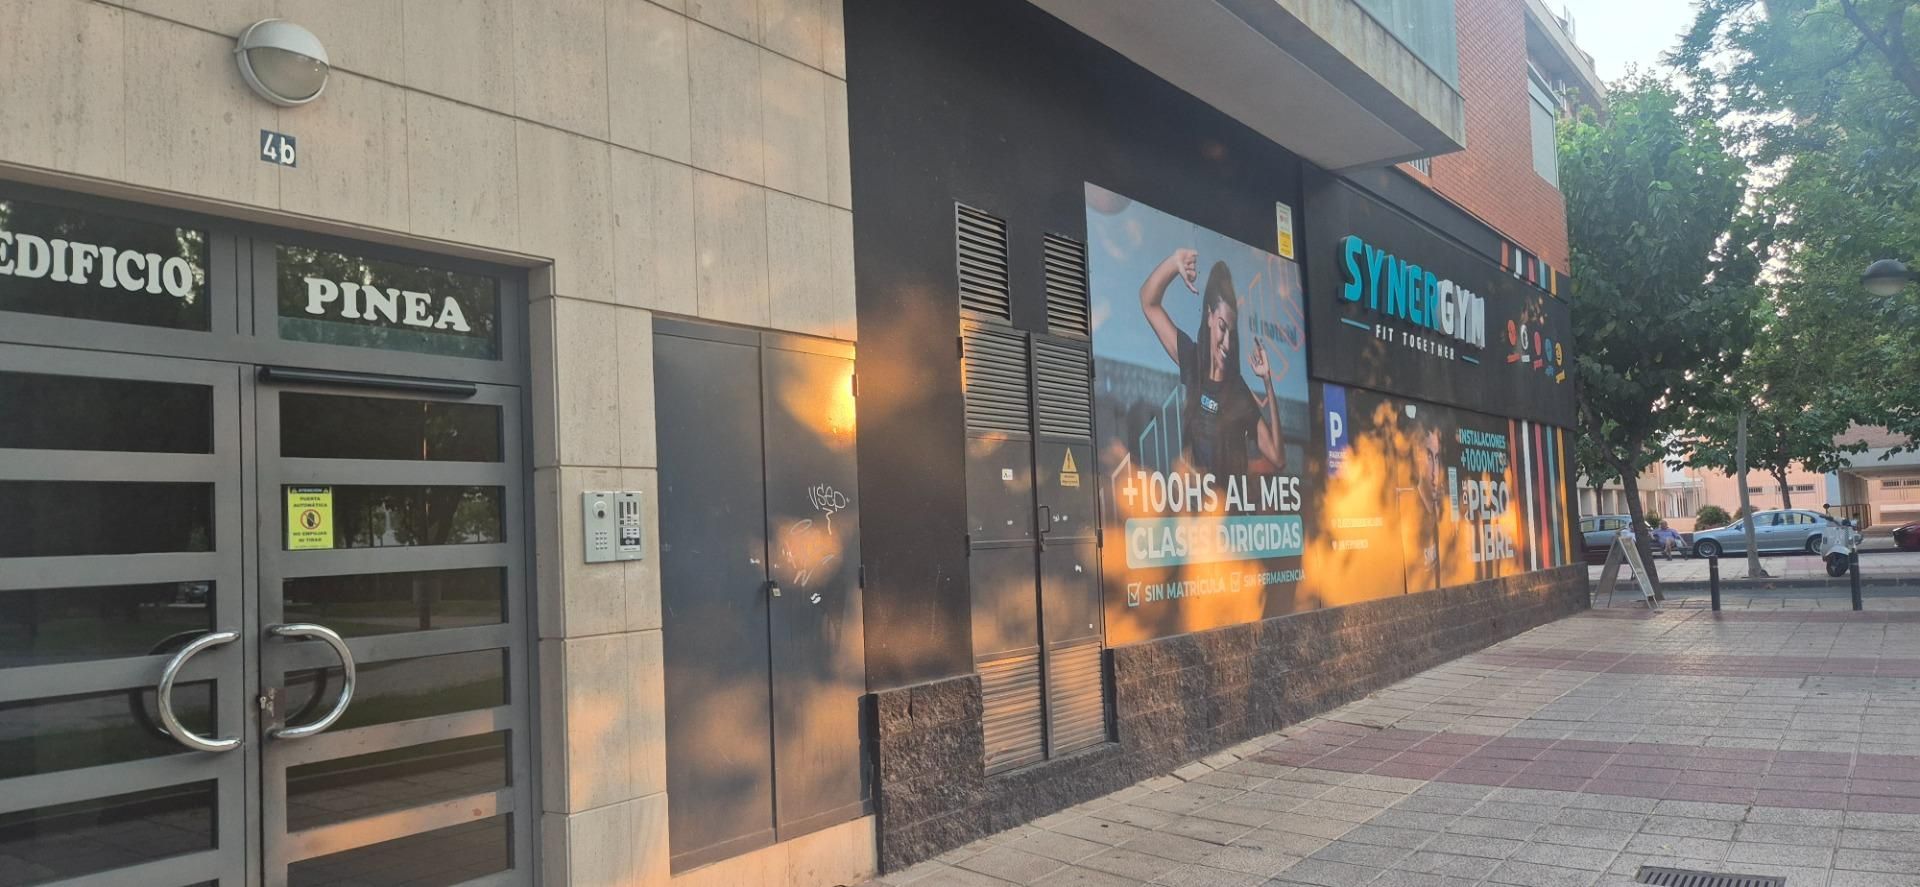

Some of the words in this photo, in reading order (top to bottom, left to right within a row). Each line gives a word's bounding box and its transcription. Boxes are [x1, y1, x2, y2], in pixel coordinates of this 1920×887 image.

[263, 133, 295, 165] 4b
[304, 277, 471, 332] PINEA
[1342, 235, 1486, 350] SYNERGYM
[1375, 324, 1394, 342] FIT
[1402, 332, 1455, 361] TOGETHER
[1329, 411, 1343, 447] P
[1459, 428, 1506, 449] INSTALACIONES
[1123, 470, 1218, 513] +100HS
[1225, 475, 1256, 512] AL
[1260, 475, 1302, 512] MES
[1468, 480, 1510, 521] PESO
[1132, 524, 1211, 561] CLASES
[1216, 522, 1301, 555] DIRIGIDAS
[1471, 521, 1514, 563] LIBRE
[1145, 584, 1164, 602] SIN
[1167, 576, 1226, 600] MATRÍCULA
[1244, 574, 1256, 588] SIN
[1258, 569, 1305, 586] PERMANENCIA
